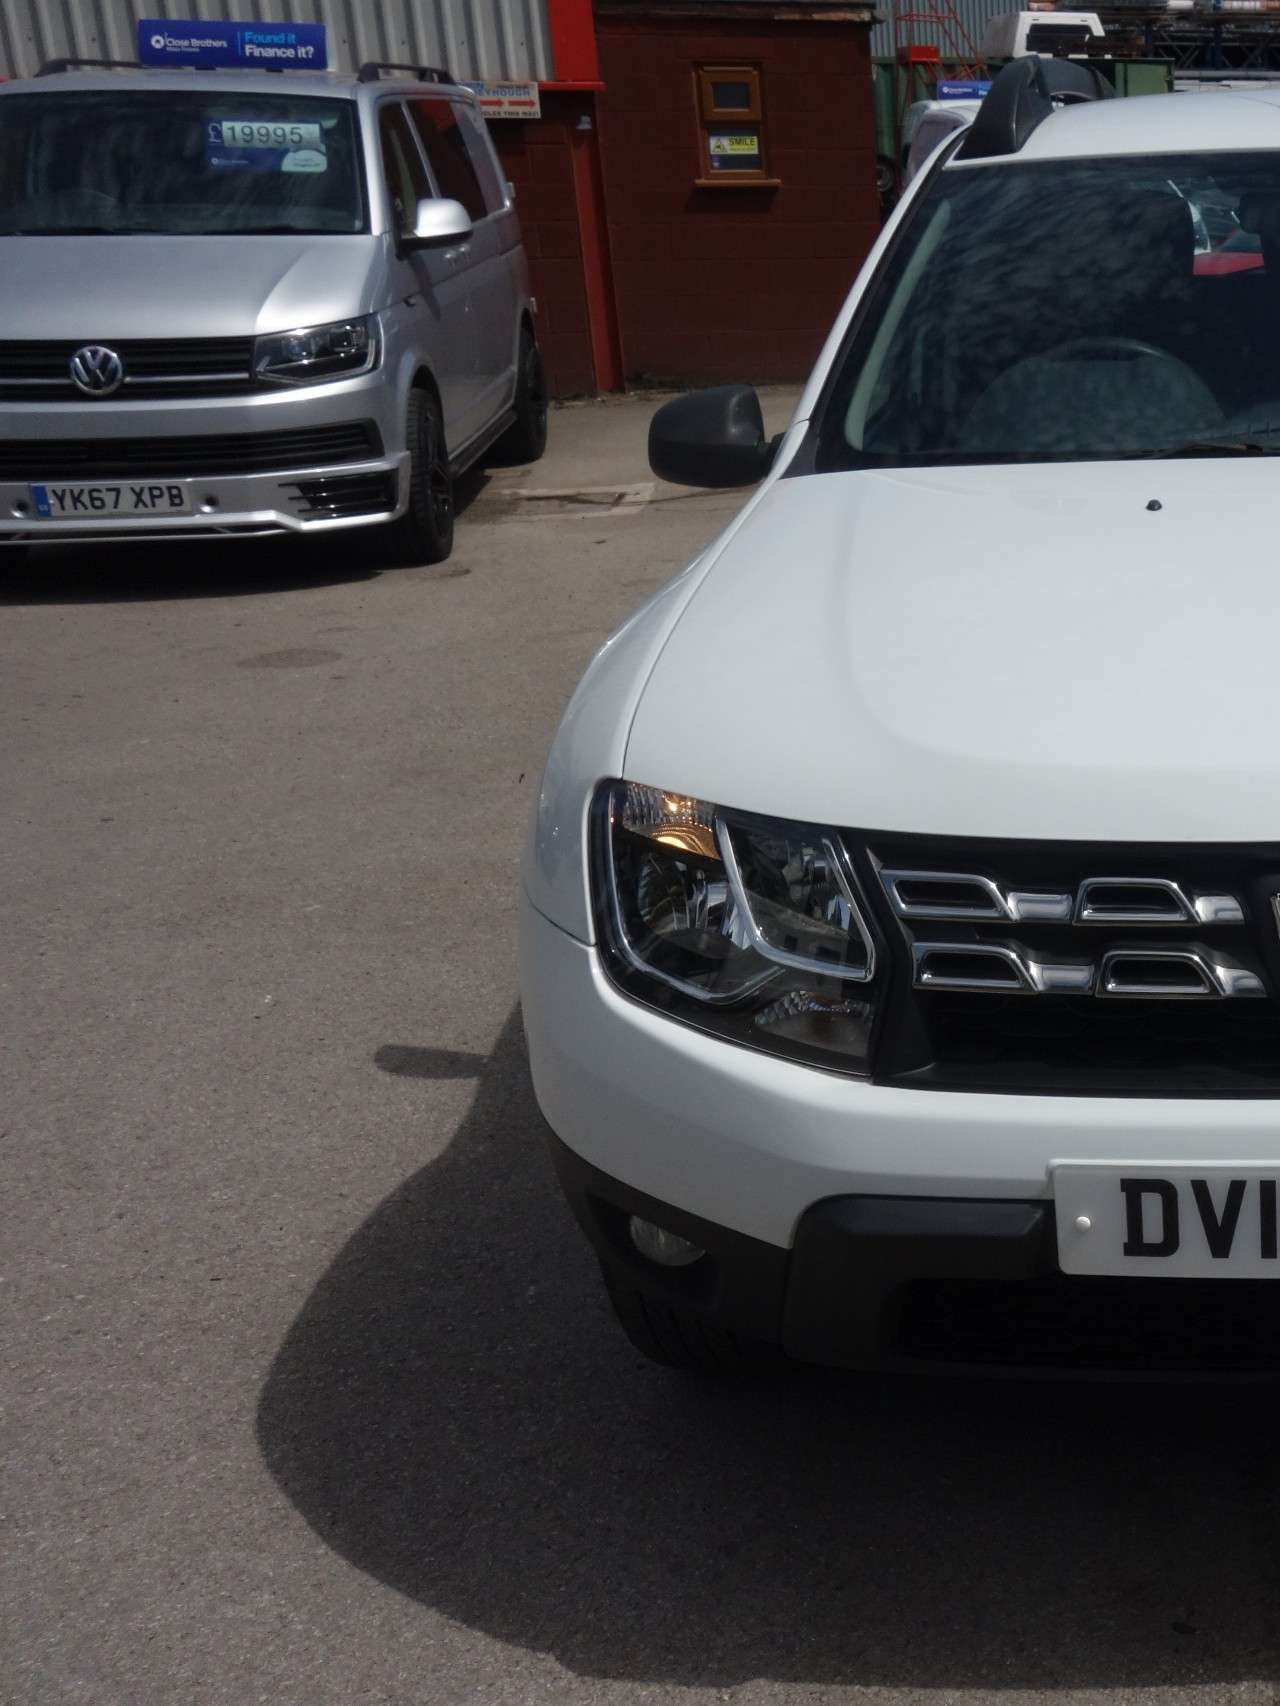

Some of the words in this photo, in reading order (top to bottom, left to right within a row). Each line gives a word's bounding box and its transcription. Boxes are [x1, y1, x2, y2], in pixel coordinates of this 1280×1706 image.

[166, 38, 190, 48] Close
[191, 39, 228, 49] Brothers
[245, 32, 284, 44] Found
[286, 33, 296, 44] it
[245, 45, 295, 58] Finance
[297, 46, 314, 59] it?
[52, 488, 121, 511] YK67
[130, 485, 184, 509] XPB
